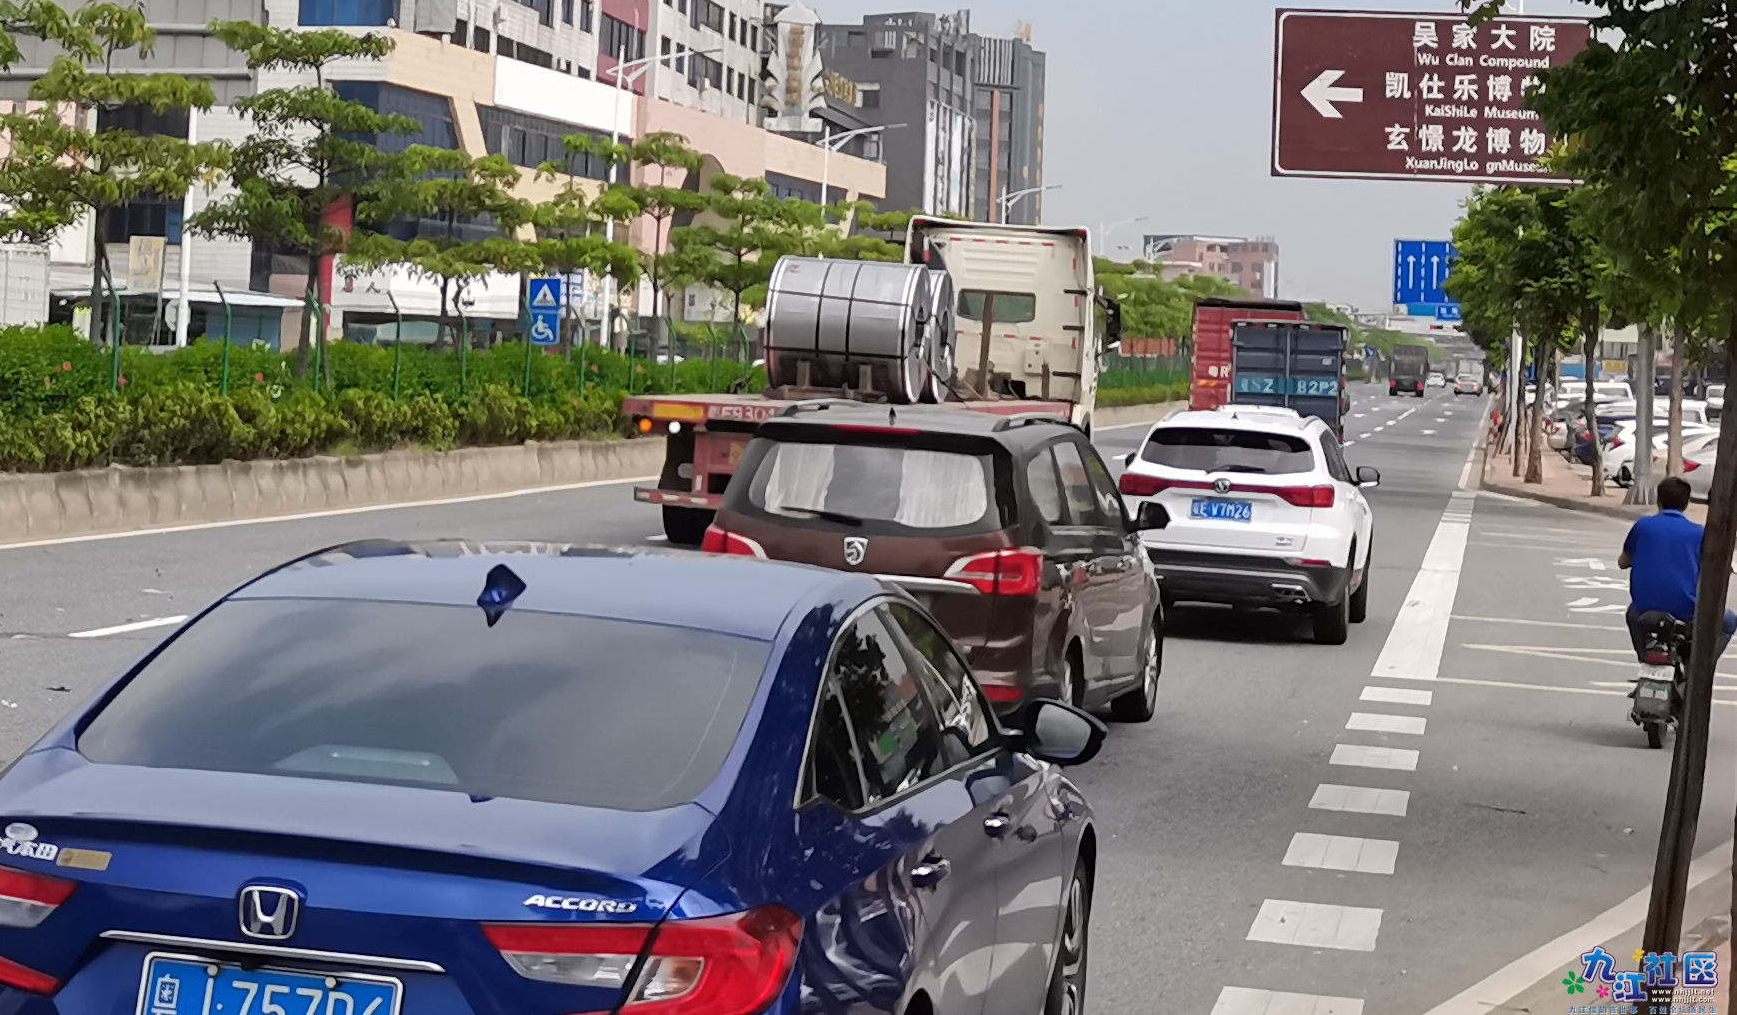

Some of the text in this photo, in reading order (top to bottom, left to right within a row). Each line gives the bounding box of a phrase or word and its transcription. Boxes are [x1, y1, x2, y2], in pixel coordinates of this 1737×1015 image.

[1413, 22, 1556, 52] 吴家大院
[1418, 53, 1550, 70] Wu Clan Compound
[1425, 104, 1477, 118] KaiShiLe
[522, 894, 638, 914] ACCORD
